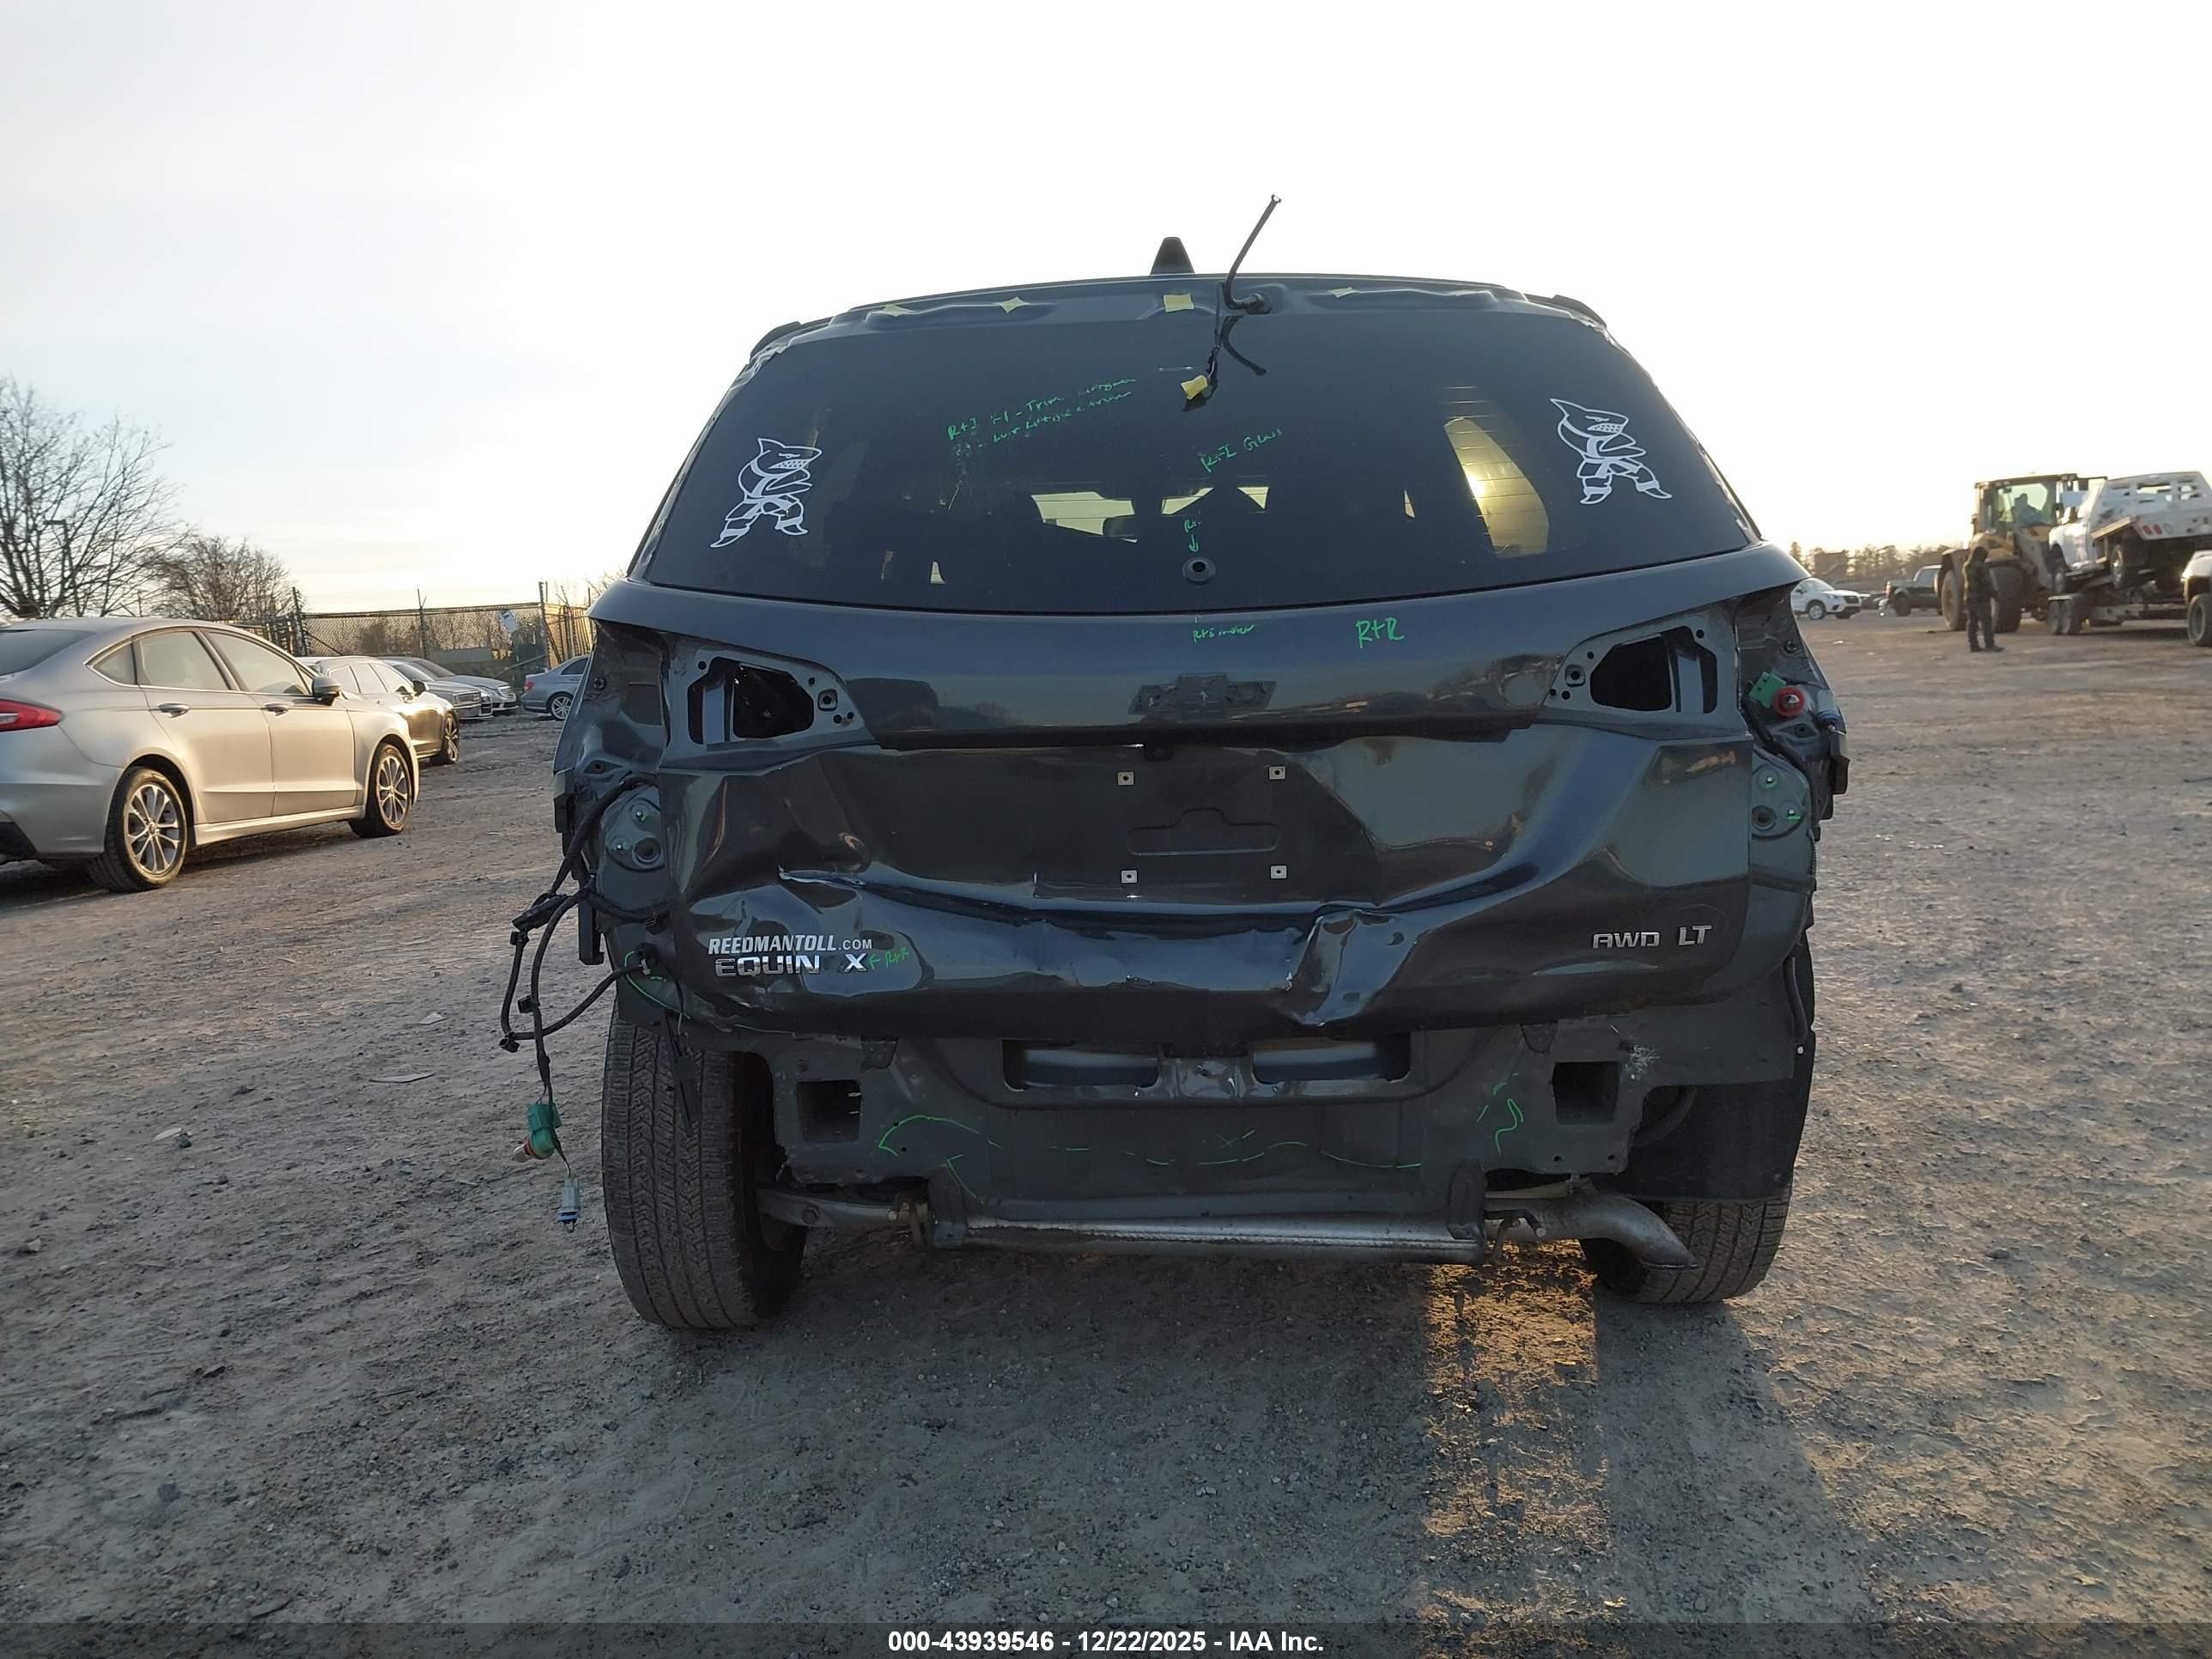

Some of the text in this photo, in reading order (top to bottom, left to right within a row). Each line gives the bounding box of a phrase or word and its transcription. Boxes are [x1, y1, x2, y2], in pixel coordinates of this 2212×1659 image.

[708, 934, 873, 955] REEDMANTOLL.COM
[1592, 925, 1713, 949] AWD LT
